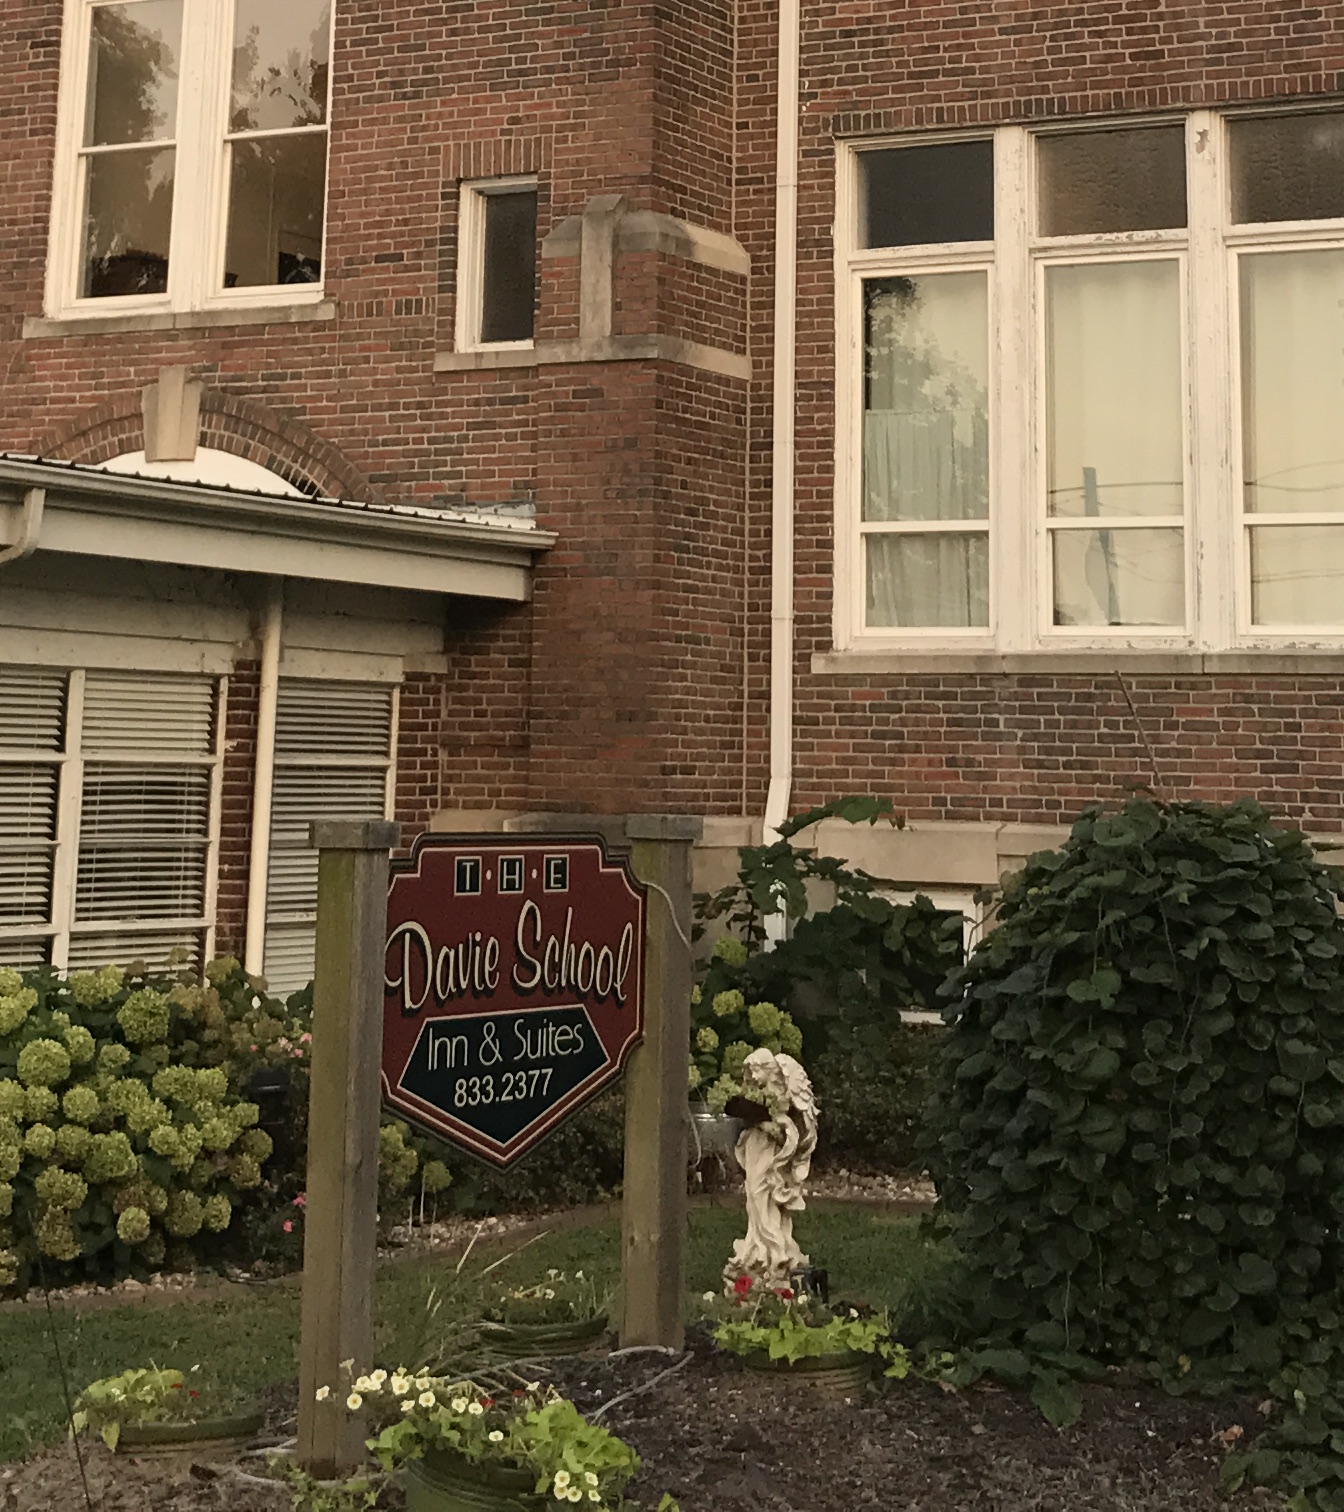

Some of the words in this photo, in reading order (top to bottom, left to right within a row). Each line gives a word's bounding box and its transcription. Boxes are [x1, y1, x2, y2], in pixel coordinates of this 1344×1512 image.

[385, 921, 499, 1009] Davie
[513, 899, 633, 1000] School
[428, 1028, 468, 1070] Inn
[479, 1021, 503, 1066] &
[513, 1018, 584, 1061] Suites
[454, 1068, 553, 1108] 833.2377
